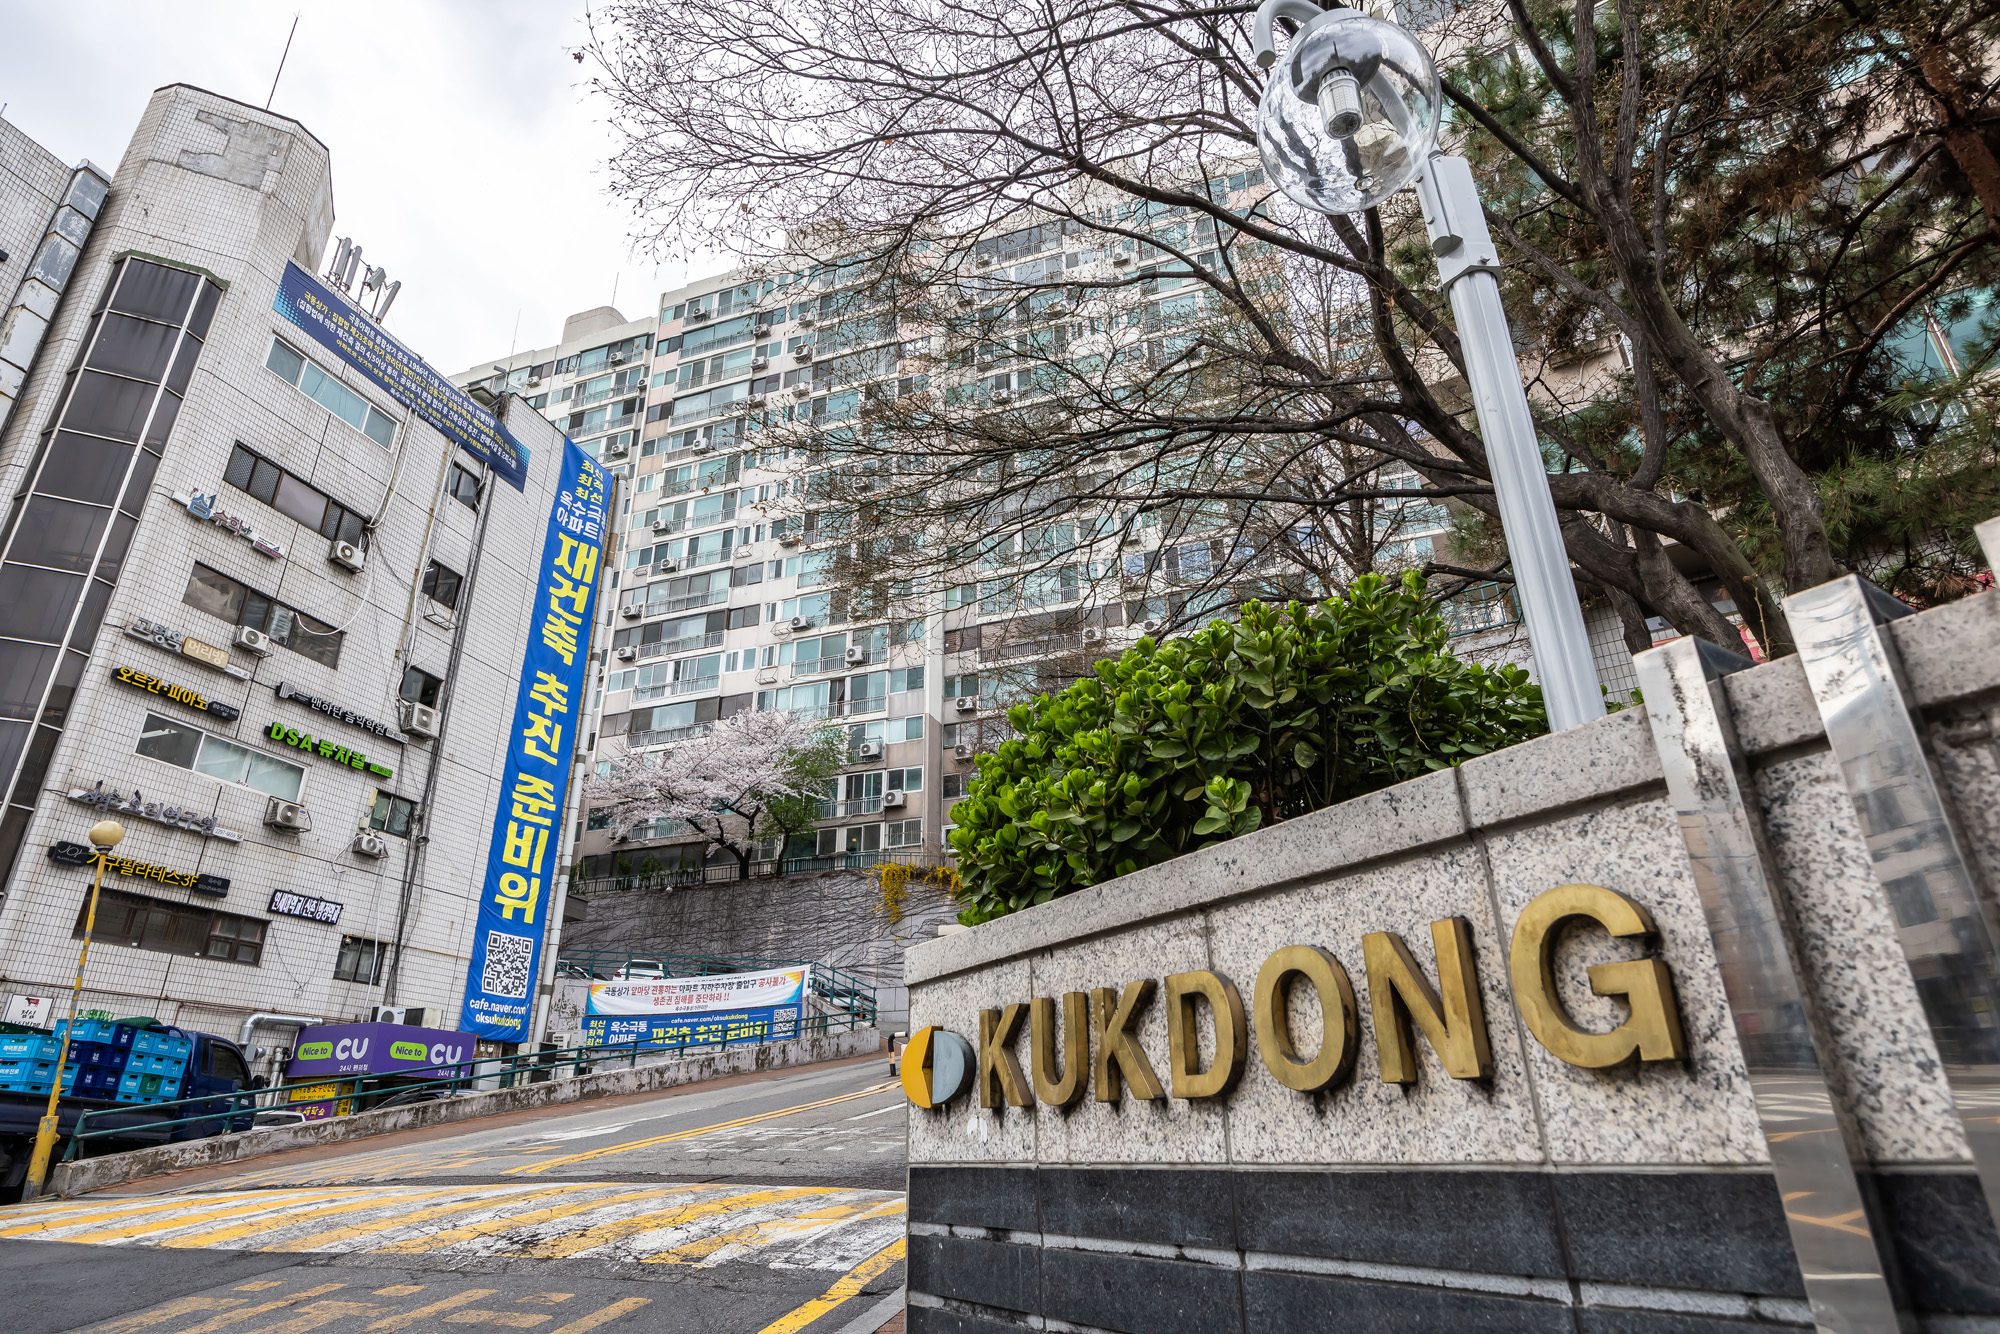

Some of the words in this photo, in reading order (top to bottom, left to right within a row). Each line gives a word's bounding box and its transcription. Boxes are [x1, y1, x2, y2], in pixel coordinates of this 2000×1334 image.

[296, 298, 323, 323] (집합법에
[323, 318, 336, 333] 의한
[336, 327, 353, 346] 재건축
[365, 351, 386, 370] 4/5이상
[304, 291, 328, 314] 극동상가
[332, 312, 349, 330] 집합법
[349, 325, 373, 349] 제23조에
[373, 344, 385, 358] 의거
[348, 312, 375, 339] 극동아파트
[581, 459, 604, 482] 최신
[578, 473, 603, 493] 최적
[575, 486, 603, 505] 최선
[556, 507, 600, 540] 아파트
[541, 532, 599, 666] 재건축
[188, 640, 225, 665] 머리방
[311, 697, 343, 719] 맨하탄
[345, 711, 386, 736] 음악학원
[523, 670, 569, 766] 추진
[270, 722, 312, 752] DSA
[319, 740, 366, 770] 뮤지컬
[121, 789, 217, 837] 요리연구원
[494, 771, 556, 925] 준비위
[604, 986, 630, 996] 극동상가
[631, 985, 651, 996] 앞마당
[651, 985, 678, 995] 관통하는
[679, 983, 699, 993] 아파트
[700, 981, 735, 992] 지하주차장
[736, 980, 757, 990] 출입구
[758, 976, 787, 987] 공사불가
[978, 882, 1688, 1109] KUKDONG
[653, 996, 672, 1006] 생존권
[674, 995, 694, 1005] 침해를
[695, 993, 723, 1004] 중단하라
[589, 1020, 606, 1028] 최신
[610, 1020, 648, 1033] 옥수극동
[671, 1013, 749, 1024] cafe.naver.com/oksukukdong
[586, 1038, 603, 1046] 최선
[588, 1029, 604, 1037] 최적
[609, 1033, 637, 1044] 아파트
[650, 1026, 691, 1044] 재건축
[695, 1024, 722, 1042] 추진
[302, 1046, 319, 1056] Nice
[320, 1046, 328, 1056] to
[335, 1037, 370, 1061] CU
[395, 1046, 414, 1057] Nice
[414, 1048, 423, 1057] to
[430, 1043, 463, 1065] CU
[353, 1063, 368, 1072] 편의점
[437, 1069, 449, 1077] 24시
[450, 1070, 465, 1078] 편점
